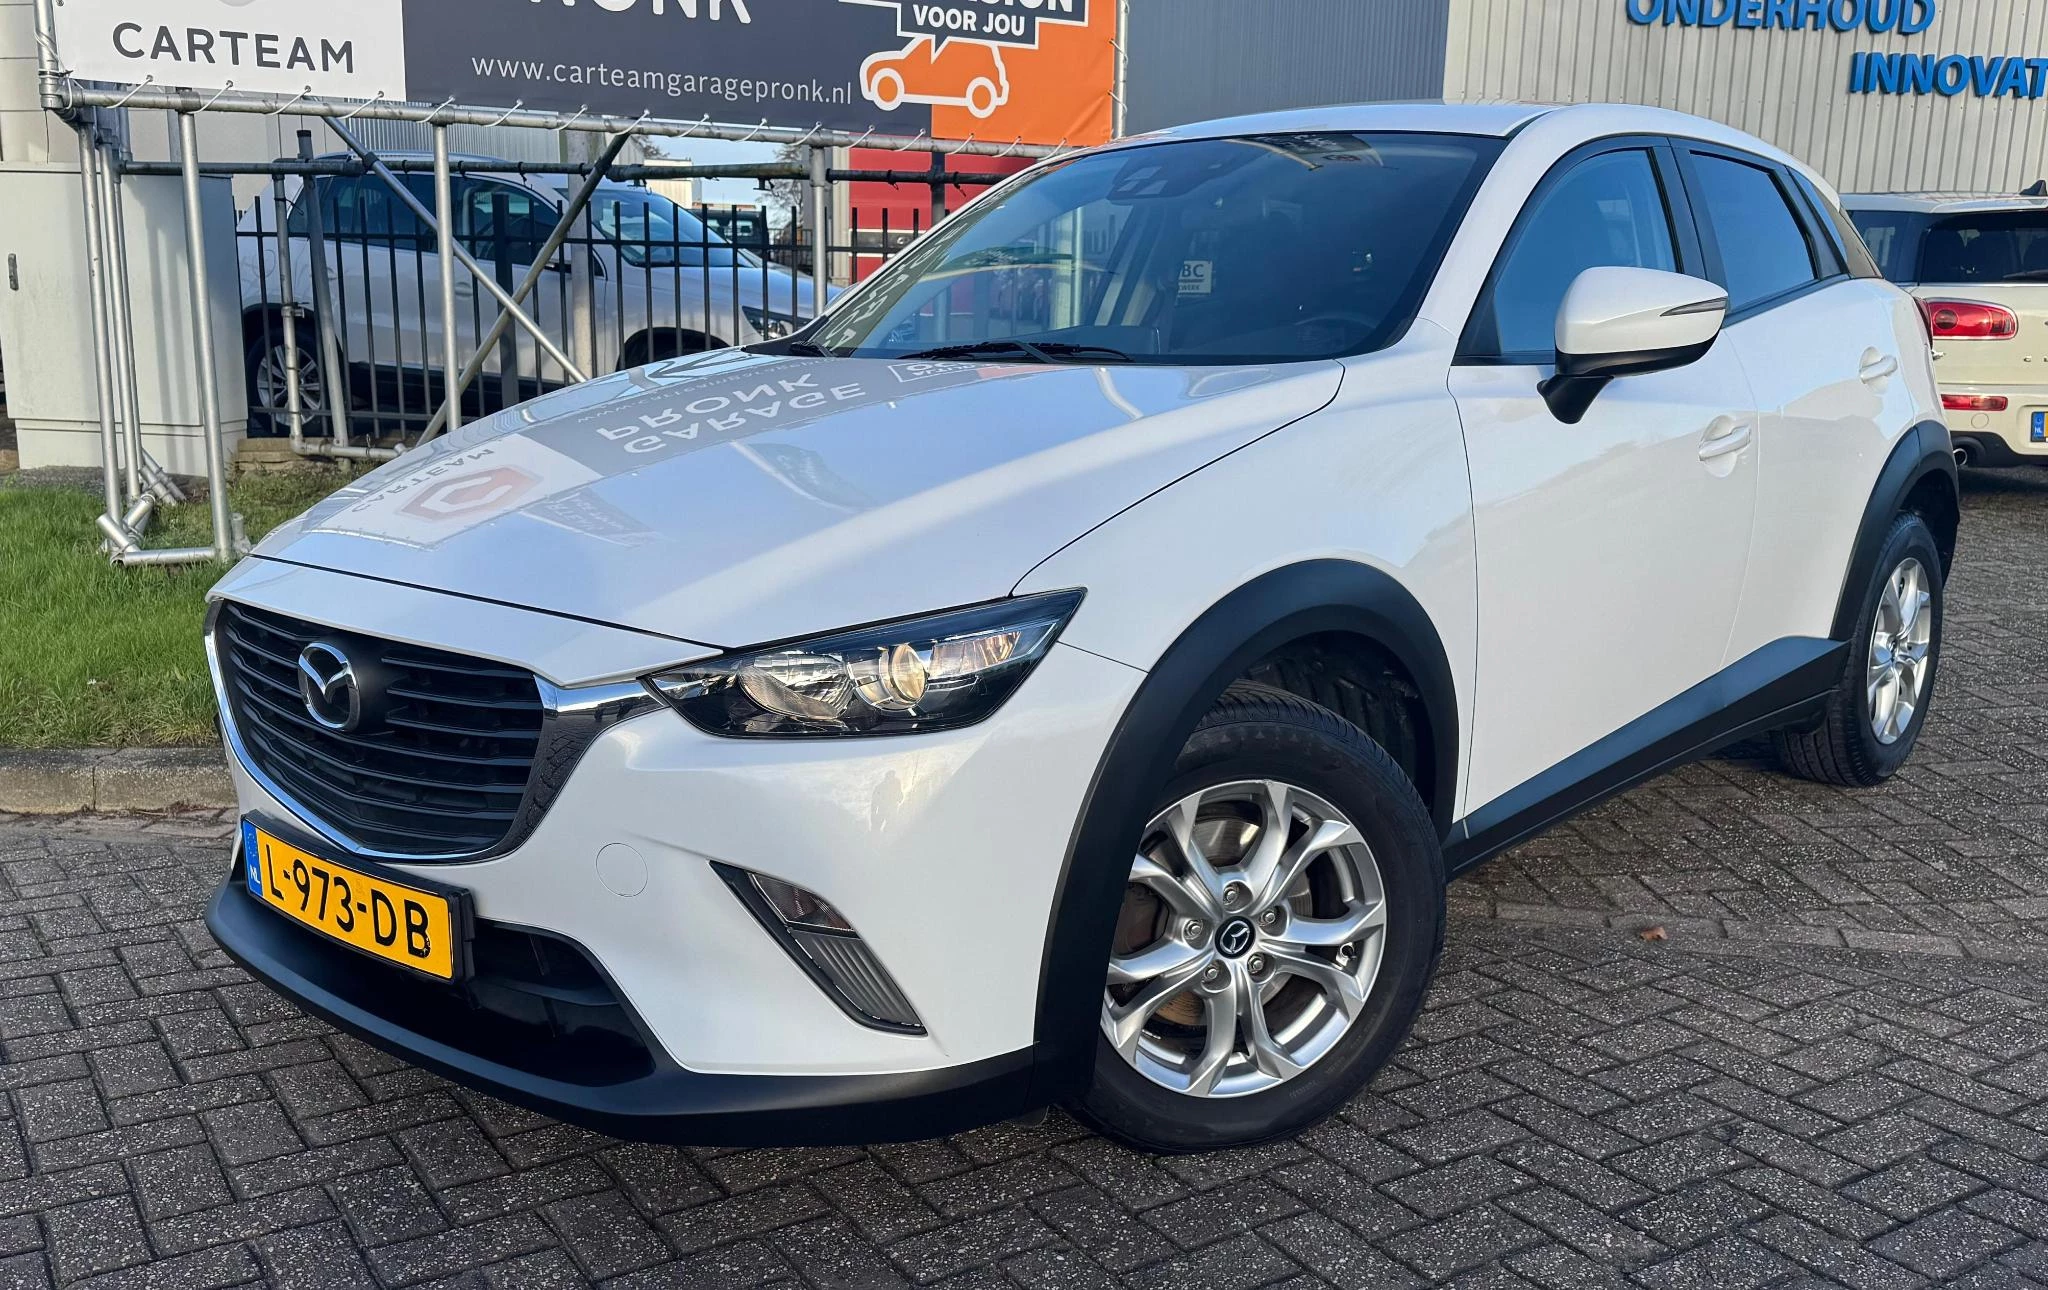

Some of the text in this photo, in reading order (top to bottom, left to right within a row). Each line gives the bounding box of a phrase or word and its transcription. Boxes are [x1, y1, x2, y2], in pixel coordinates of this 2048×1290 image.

[912, 4, 977, 32] VOOR
[982, 12, 1026, 37] JOU
[1626, 0, 1937, 35] ONDERHOUD
[112, 22, 354, 74] CARTEAM
[471, 56, 852, 105] www.carteamgaragepronk.nl
[1848, 51, 2048, 100] INNOVAT
[249, 864, 261, 885] NL
[265, 843, 432, 959] L-973-DB
